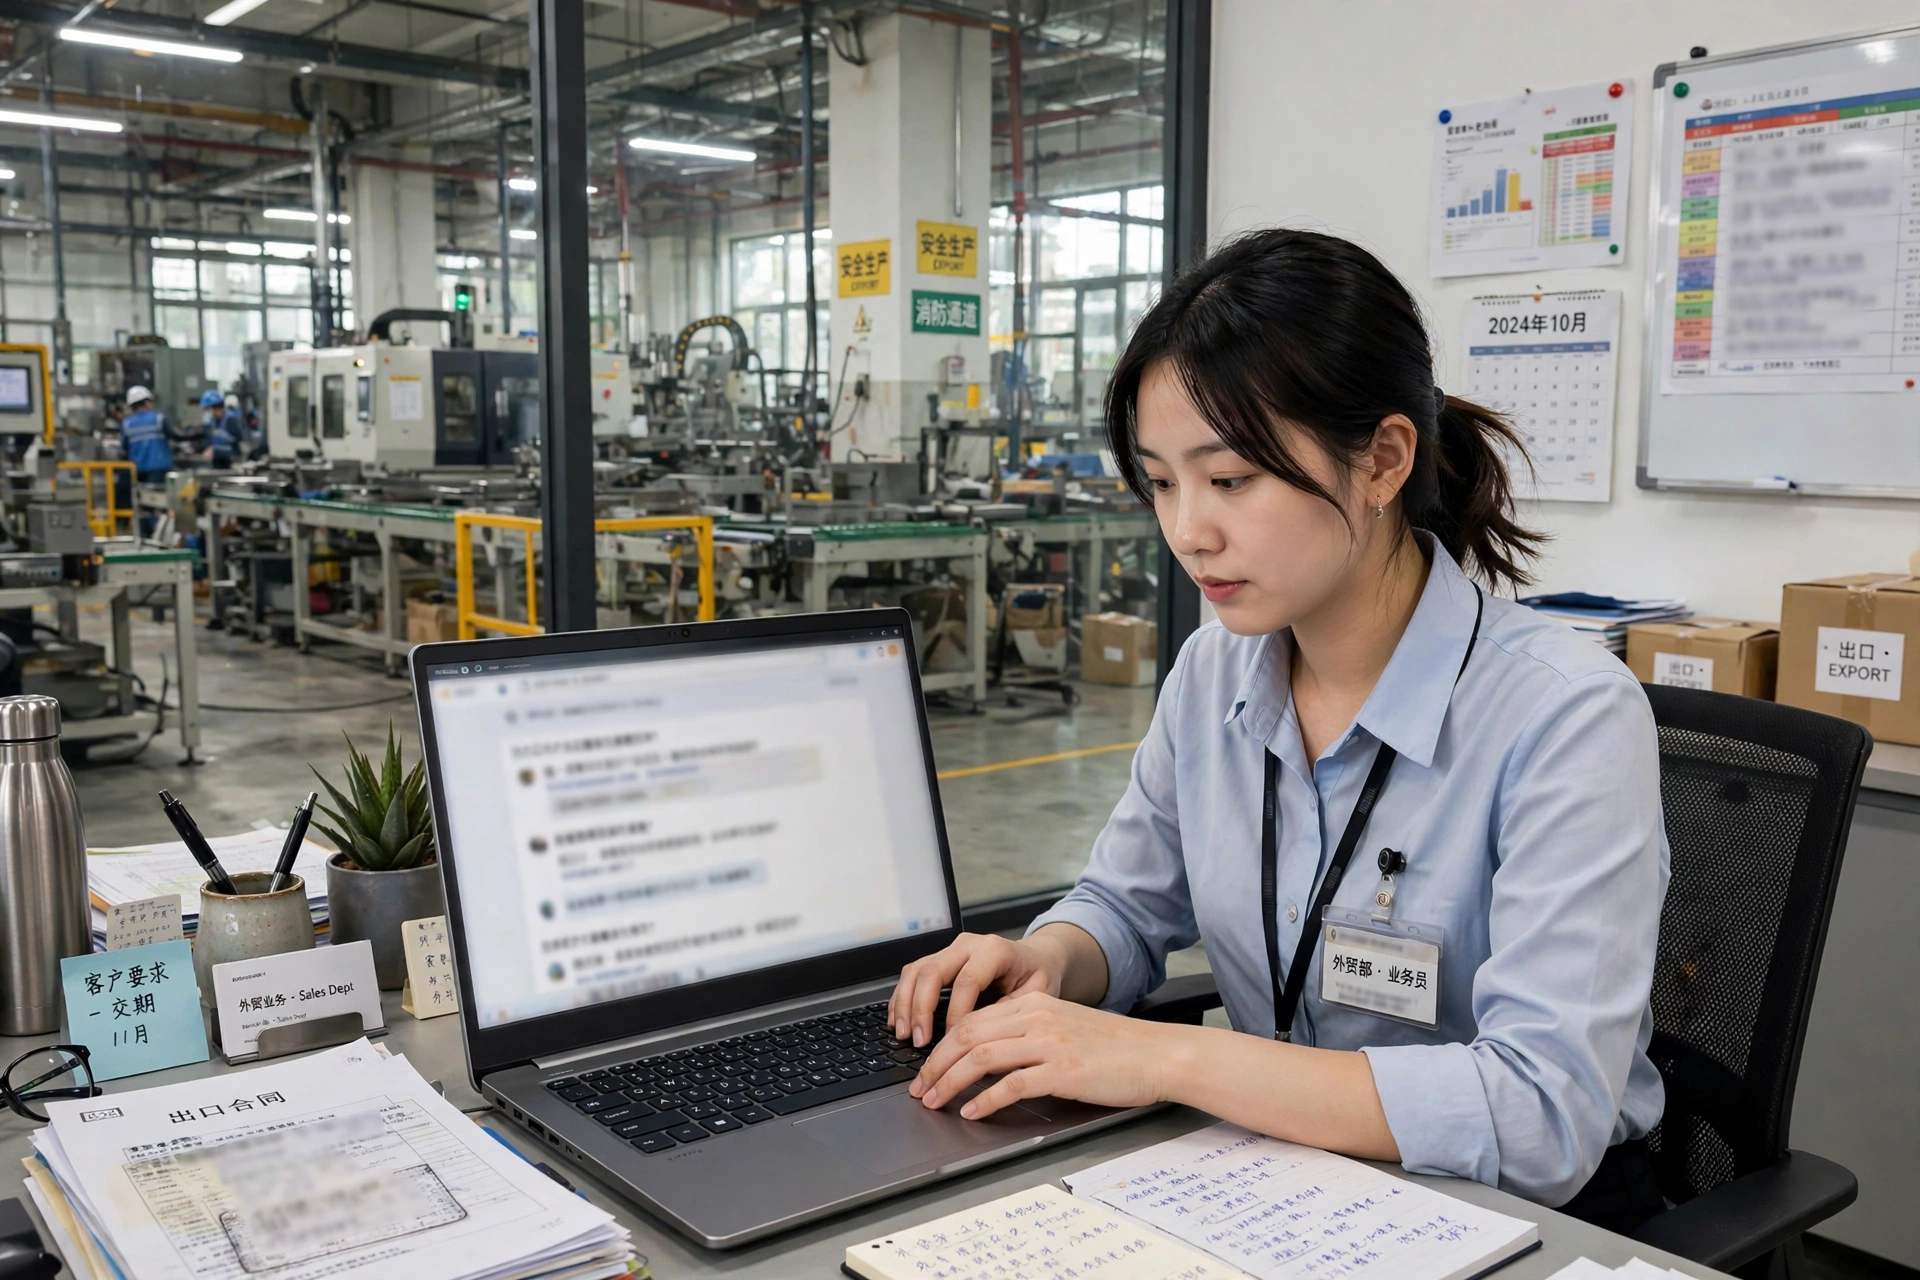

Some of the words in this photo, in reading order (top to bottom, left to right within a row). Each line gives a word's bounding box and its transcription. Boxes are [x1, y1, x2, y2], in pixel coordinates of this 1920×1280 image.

[920, 230, 975, 258] 安全生产
[841, 250, 888, 278] 安全生产
[916, 298, 977, 328] 消防通道
[1488, 312, 1587, 334] 2024年10月
[1839, 641, 1875, 661] 出口
[1669, 661, 1694, 676] 出口
[1829, 663, 1892, 682] EXPORT
[84, 961, 170, 996] 客户要求
[112, 993, 156, 1020] 交期
[239, 993, 287, 1013] 外贸业务
[299, 988, 326, 1002] Sales
[328, 982, 355, 996] Dept
[113, 1024, 149, 1047] 11月
[168, 1091, 286, 1124] 出口合同
